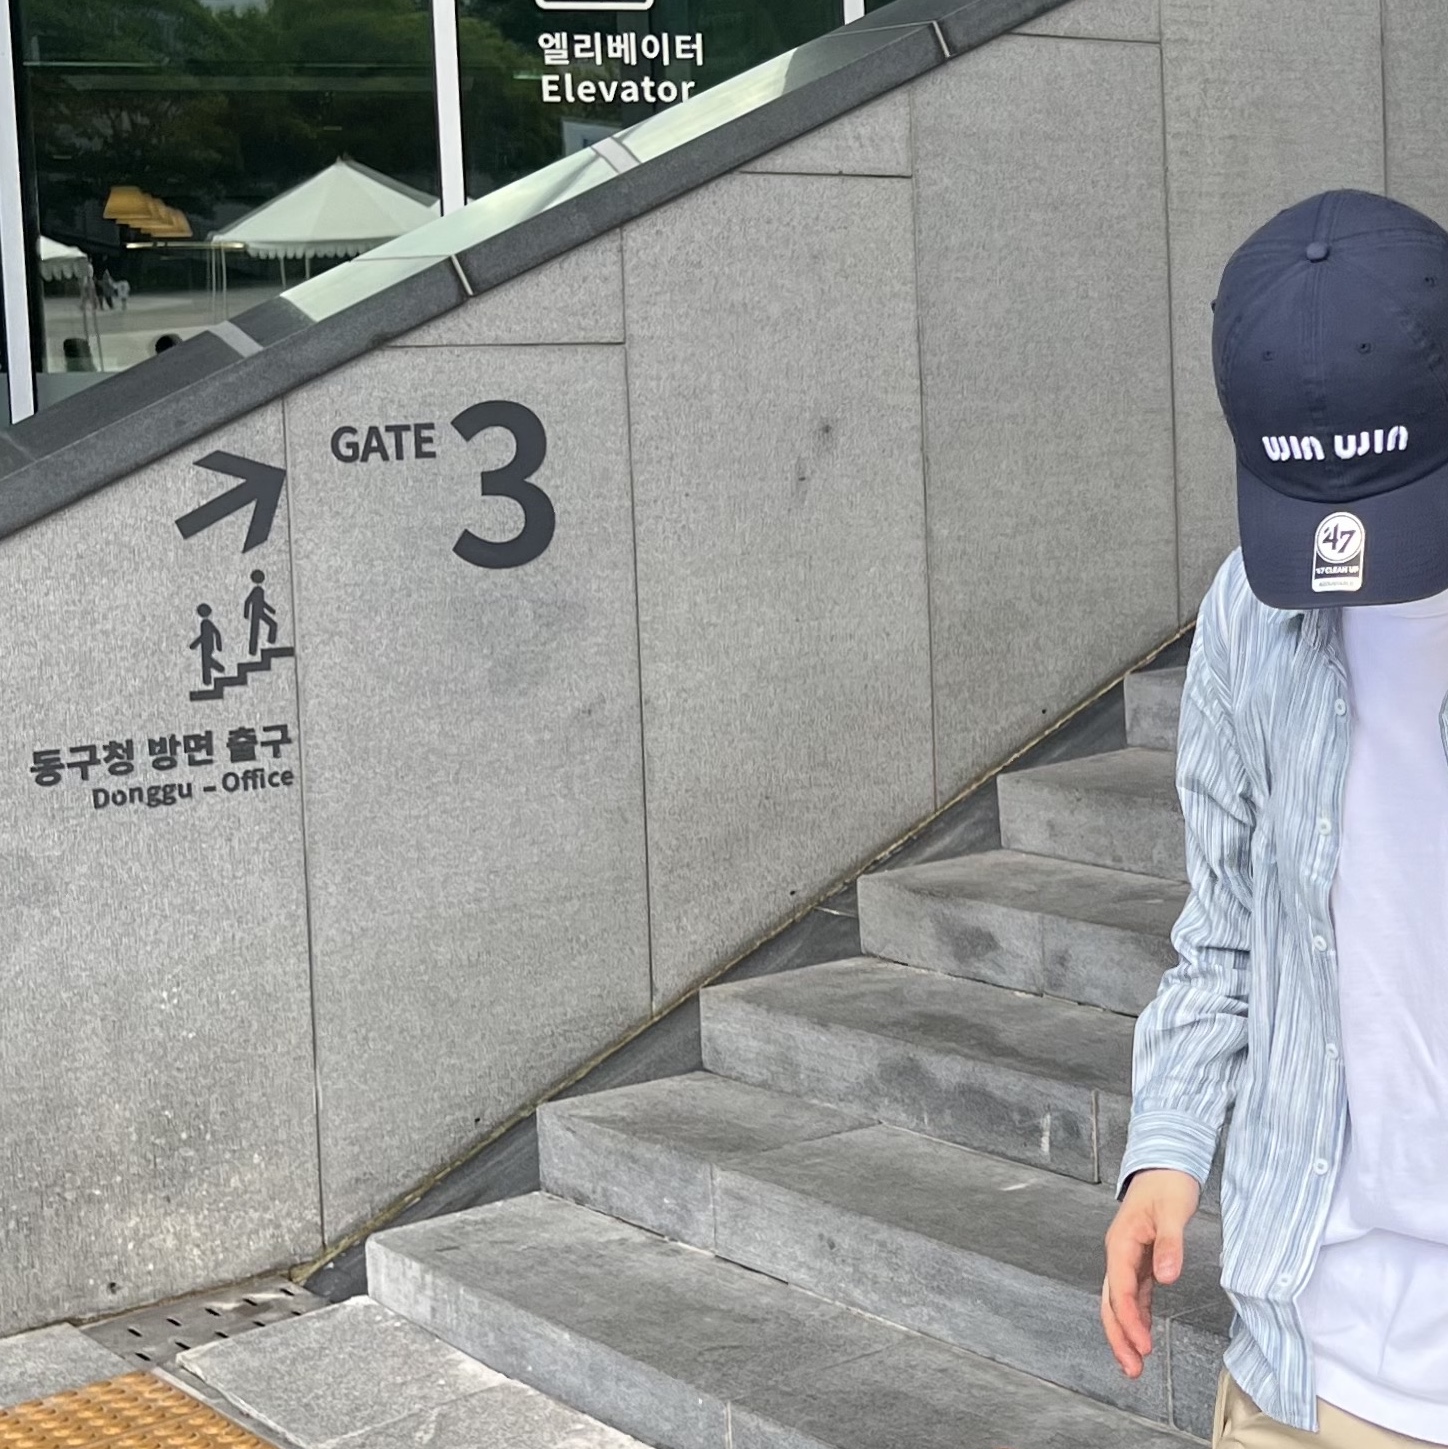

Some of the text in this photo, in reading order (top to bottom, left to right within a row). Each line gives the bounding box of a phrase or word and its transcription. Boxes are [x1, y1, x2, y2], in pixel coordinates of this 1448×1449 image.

[538, 31, 703, 66] 엘리베이터
[541, 73, 695, 103] Elevator
[330, 400, 556, 569] GATE 3
[30, 724, 292, 787] 동구청 방면 출구
[92, 782, 193, 809] Donggu
[222, 768, 294, 793] Office
